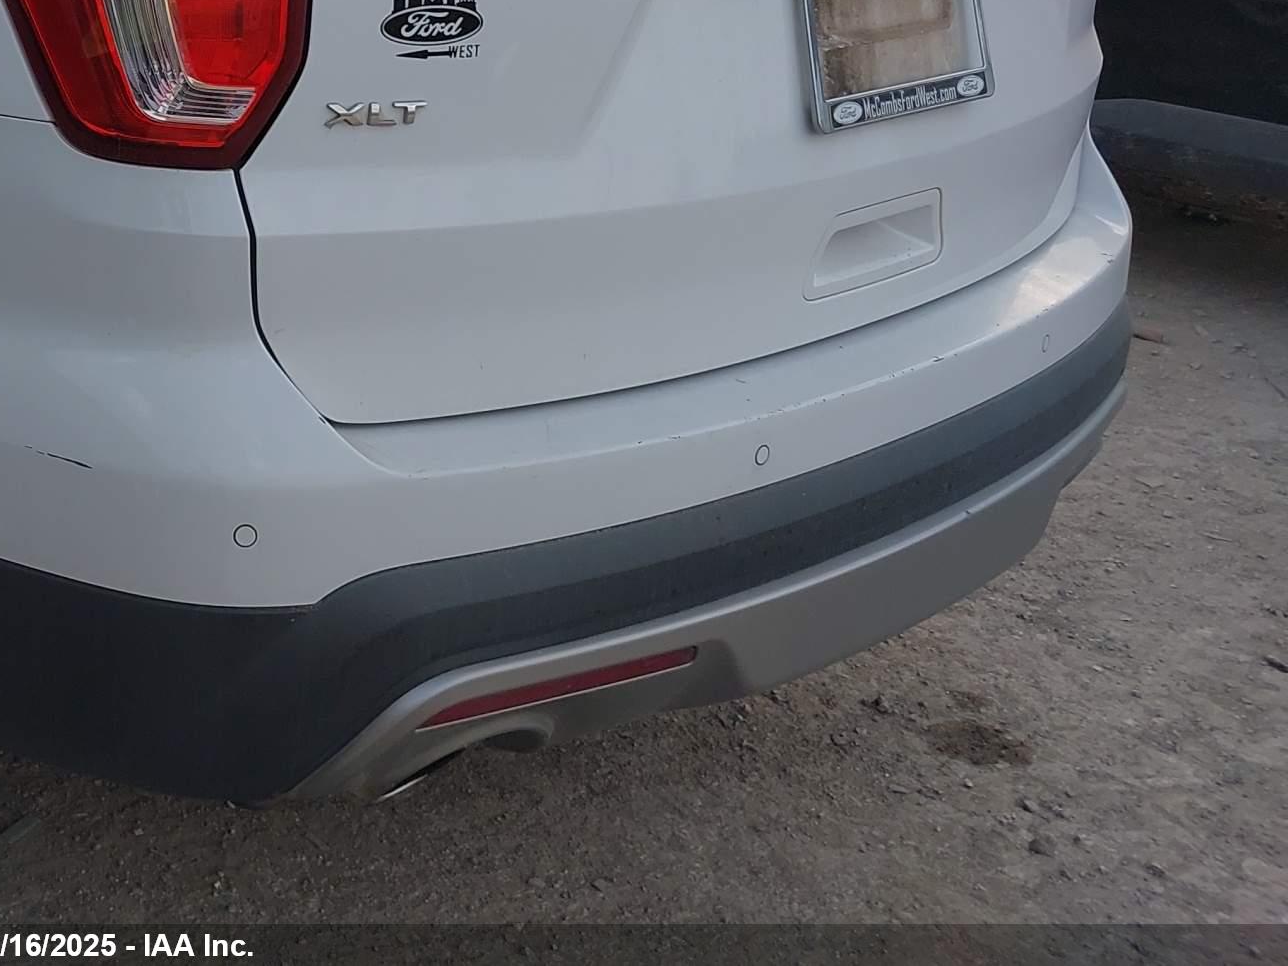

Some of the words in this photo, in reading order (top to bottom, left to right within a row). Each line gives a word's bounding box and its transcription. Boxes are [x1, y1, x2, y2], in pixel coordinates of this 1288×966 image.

[400, 11, 464, 38] Ford
[448, 44, 481, 59] WEST
[324, 100, 428, 129] XLT
[863, 84, 958, 121] McCombsFordWest.com
